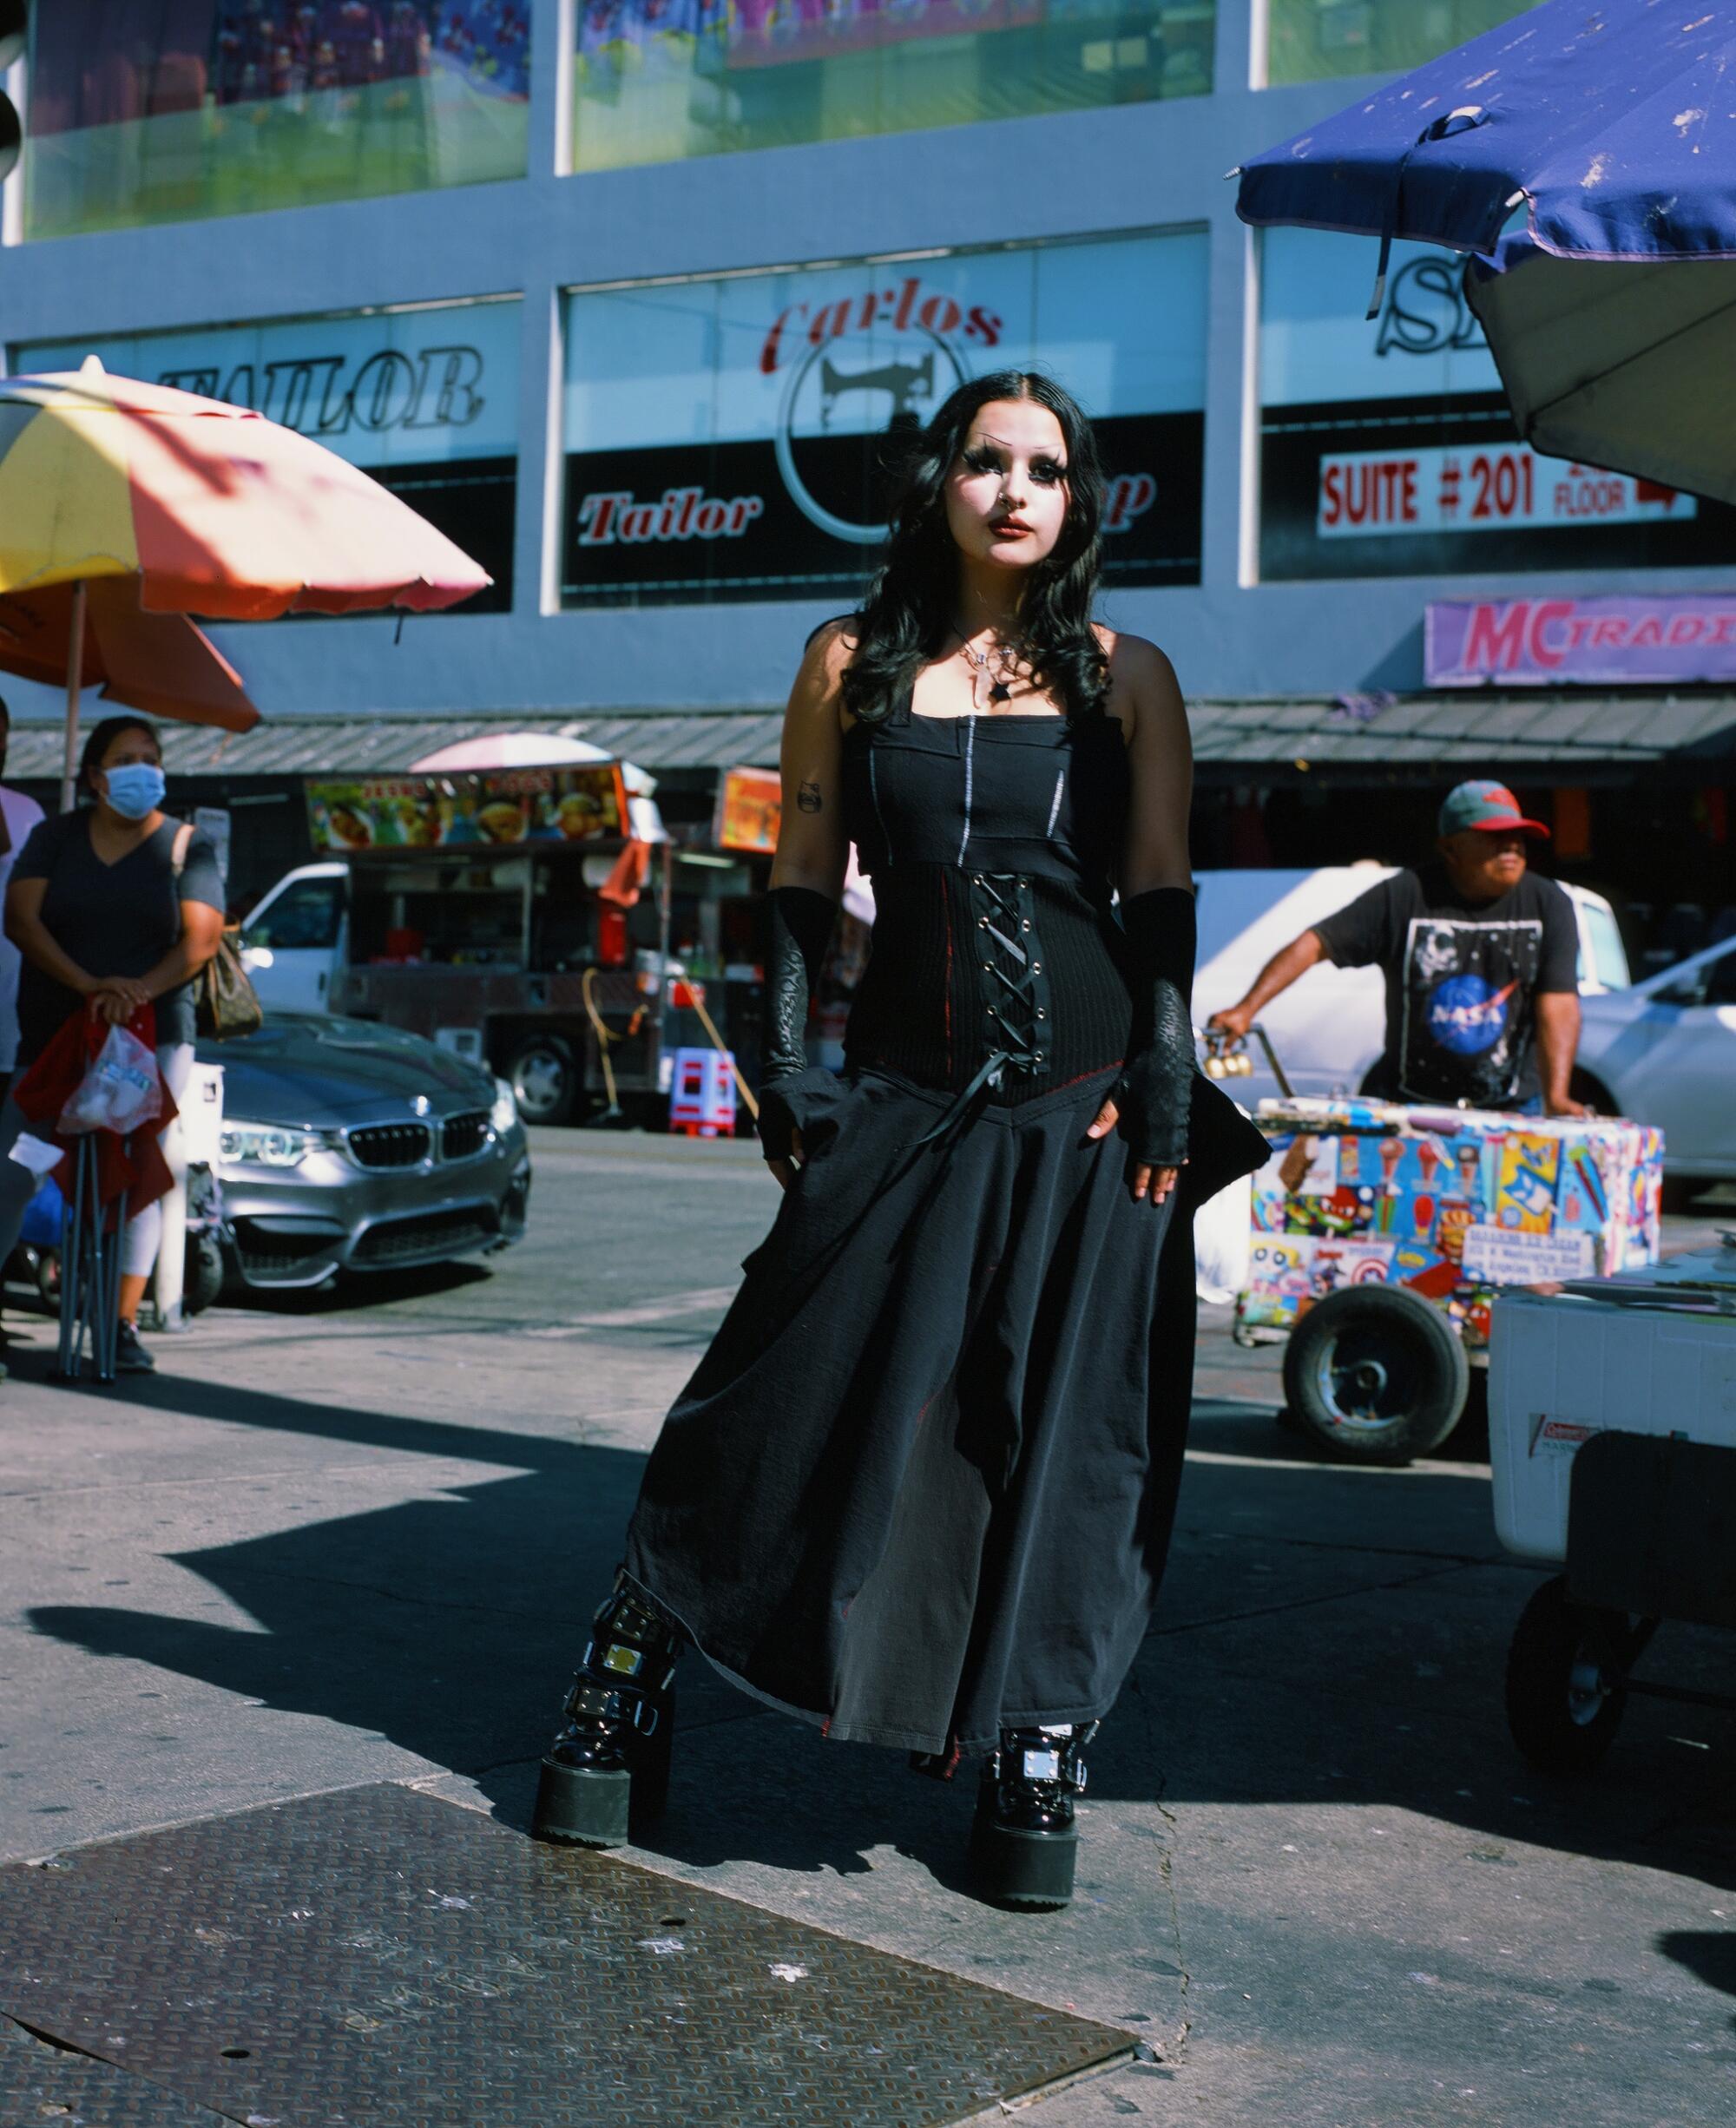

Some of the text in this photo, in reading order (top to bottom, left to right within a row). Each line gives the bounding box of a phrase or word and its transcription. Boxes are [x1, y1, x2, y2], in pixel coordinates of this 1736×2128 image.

[760, 277, 1003, 375] Carlos
[577, 486, 764, 547] Tailor
[1322, 460, 1418, 527] SUITE
[1555, 479, 1626, 517] FLOOR
[1430, 1003, 1503, 1027] NASA
